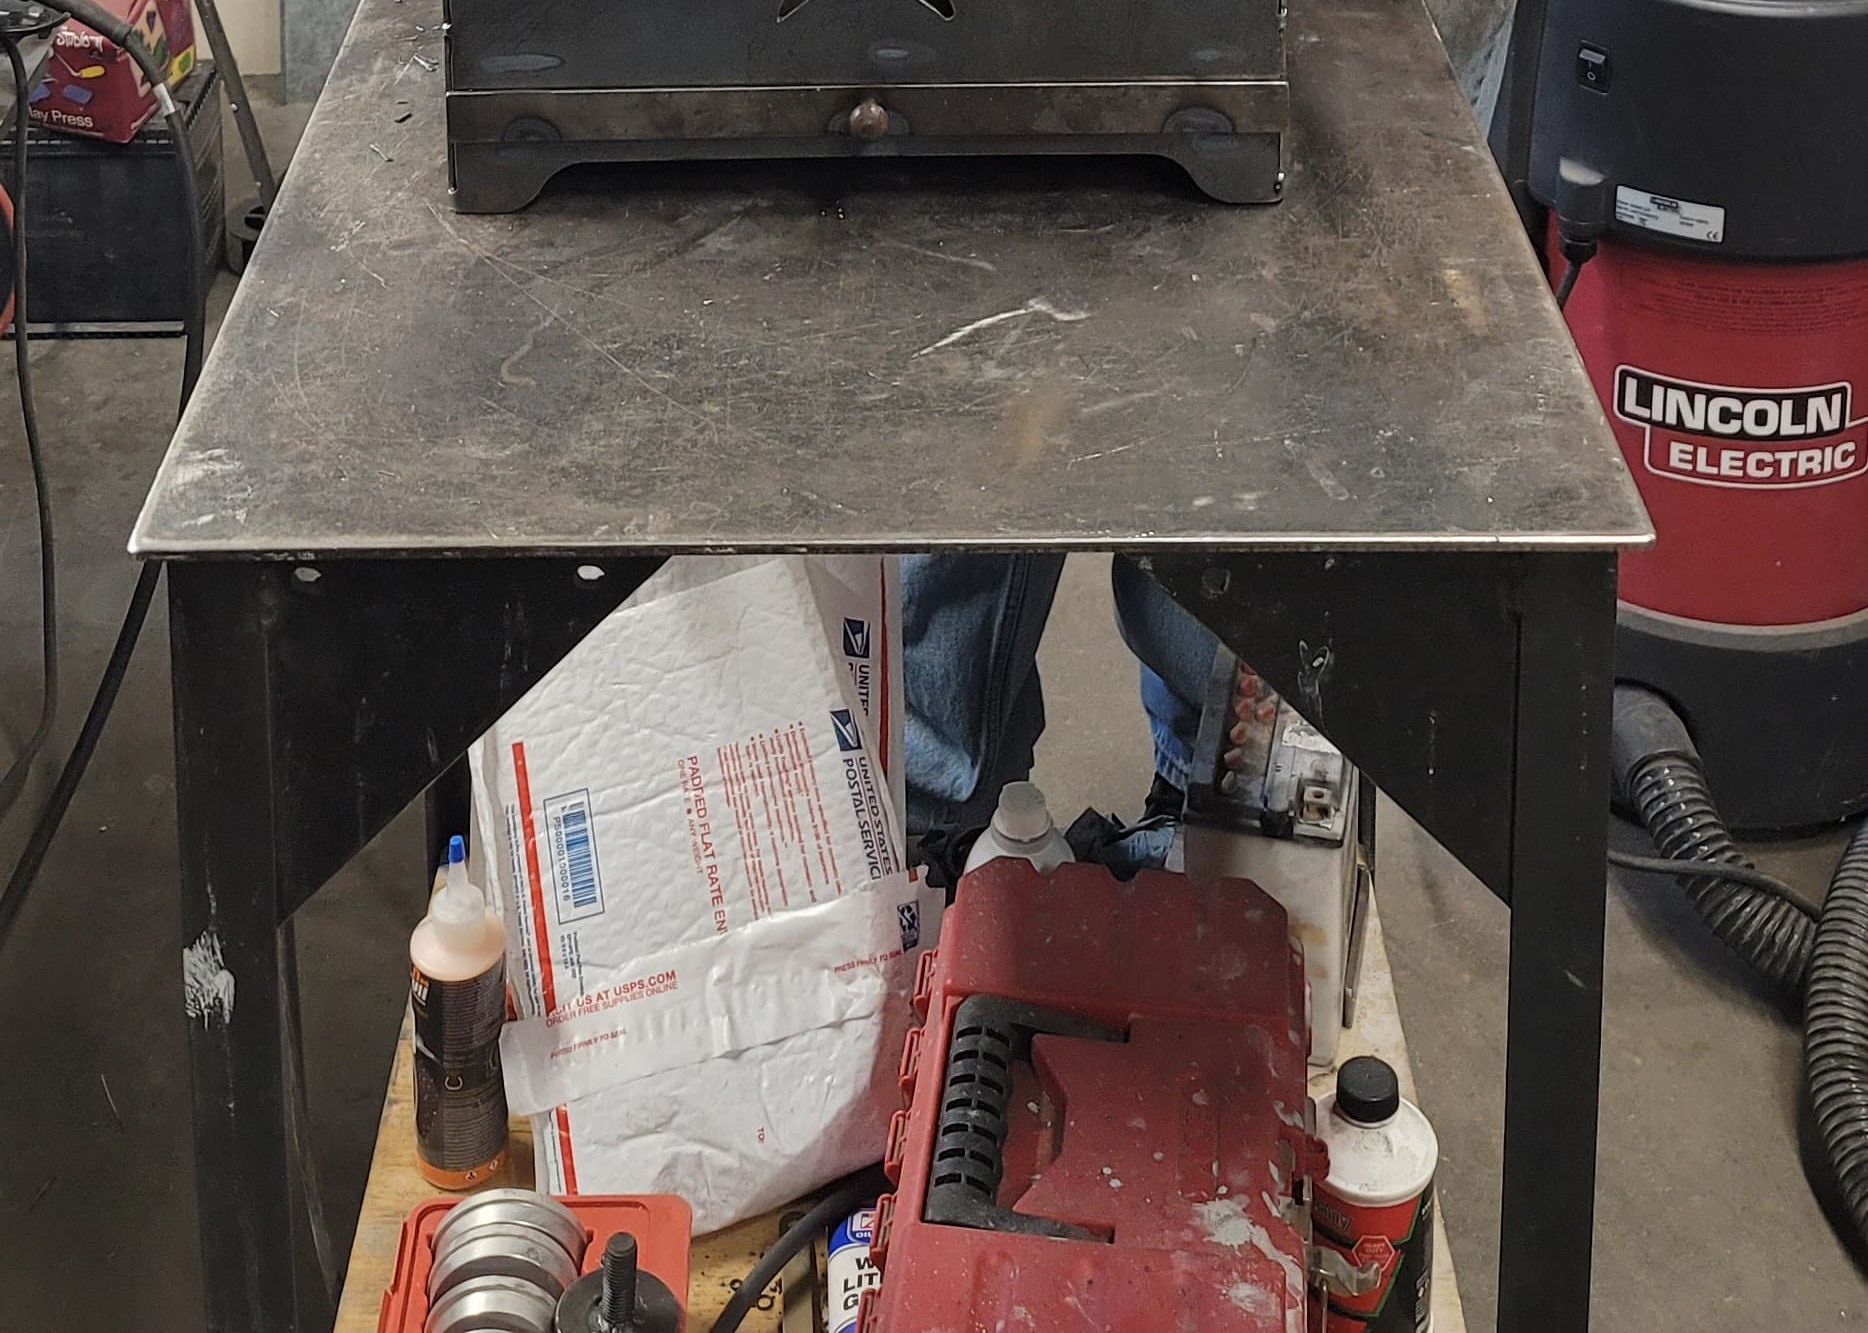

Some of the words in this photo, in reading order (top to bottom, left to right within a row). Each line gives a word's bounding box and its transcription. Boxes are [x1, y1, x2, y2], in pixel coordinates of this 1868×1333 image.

[51, 110, 93, 128] Press
[1624, 376, 1842, 436] LINCOLN
[1669, 441, 1856, 478] ELECTRIC
[687, 755, 707, 819] PADDED
[843, 758, 865, 819] POSTAL
[859, 756, 880, 817] UNITED
[875, 820, 893, 875] STATES
[700, 822, 716, 859] FLAT
[706, 864, 724, 908] RATE
[714, 909, 728, 933] EN
[546, 1008, 577, 1028] ORDER
[579, 1004, 600, 1018] FREE
[602, 992, 644, 1009] SUPPLIES
[646, 981, 678, 997] ONLINE
[576, 994, 593, 1007] US
[596, 989, 610, 1003] AT
[613, 970, 676, 996] USPS.COM
